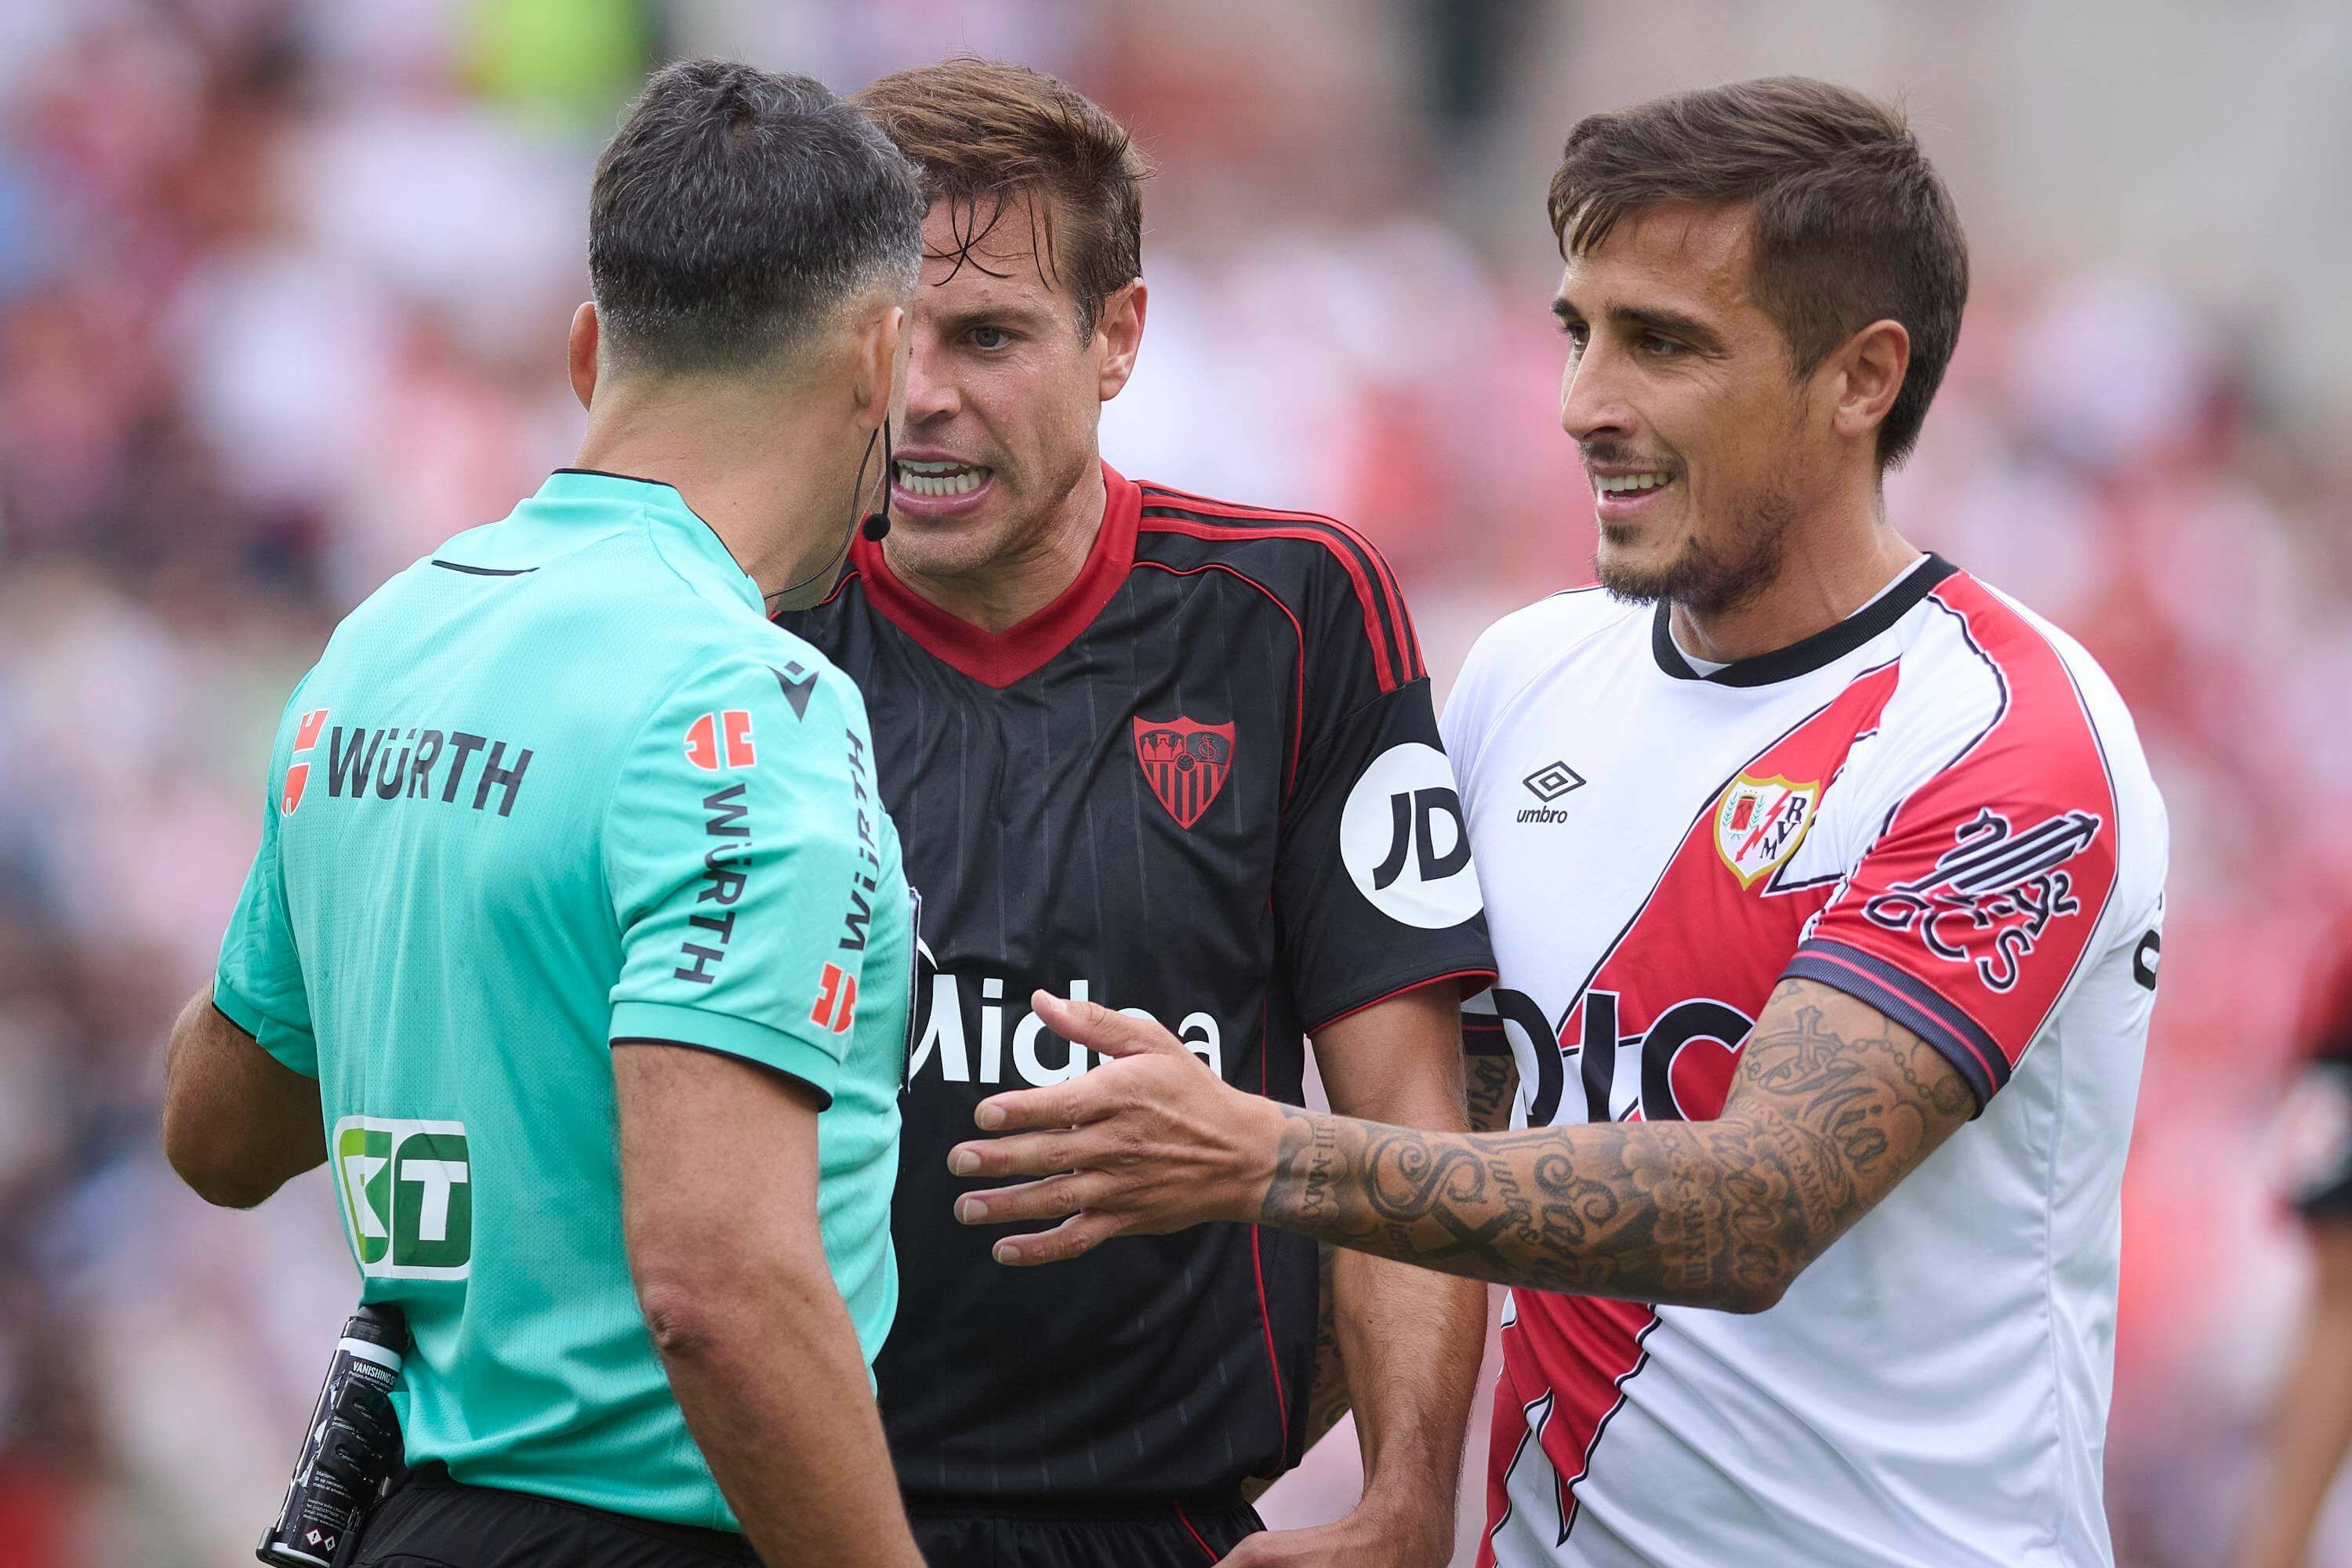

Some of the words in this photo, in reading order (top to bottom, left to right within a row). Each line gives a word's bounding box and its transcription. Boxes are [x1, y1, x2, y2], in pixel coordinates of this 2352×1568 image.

[328, 726, 534, 817] WÜRTH
[1516, 804, 1568, 824] umbro
[673, 782, 752, 985] WÜRTH
[1372, 786, 1472, 891] JD
[353, 1360, 391, 1384] VANISHING
